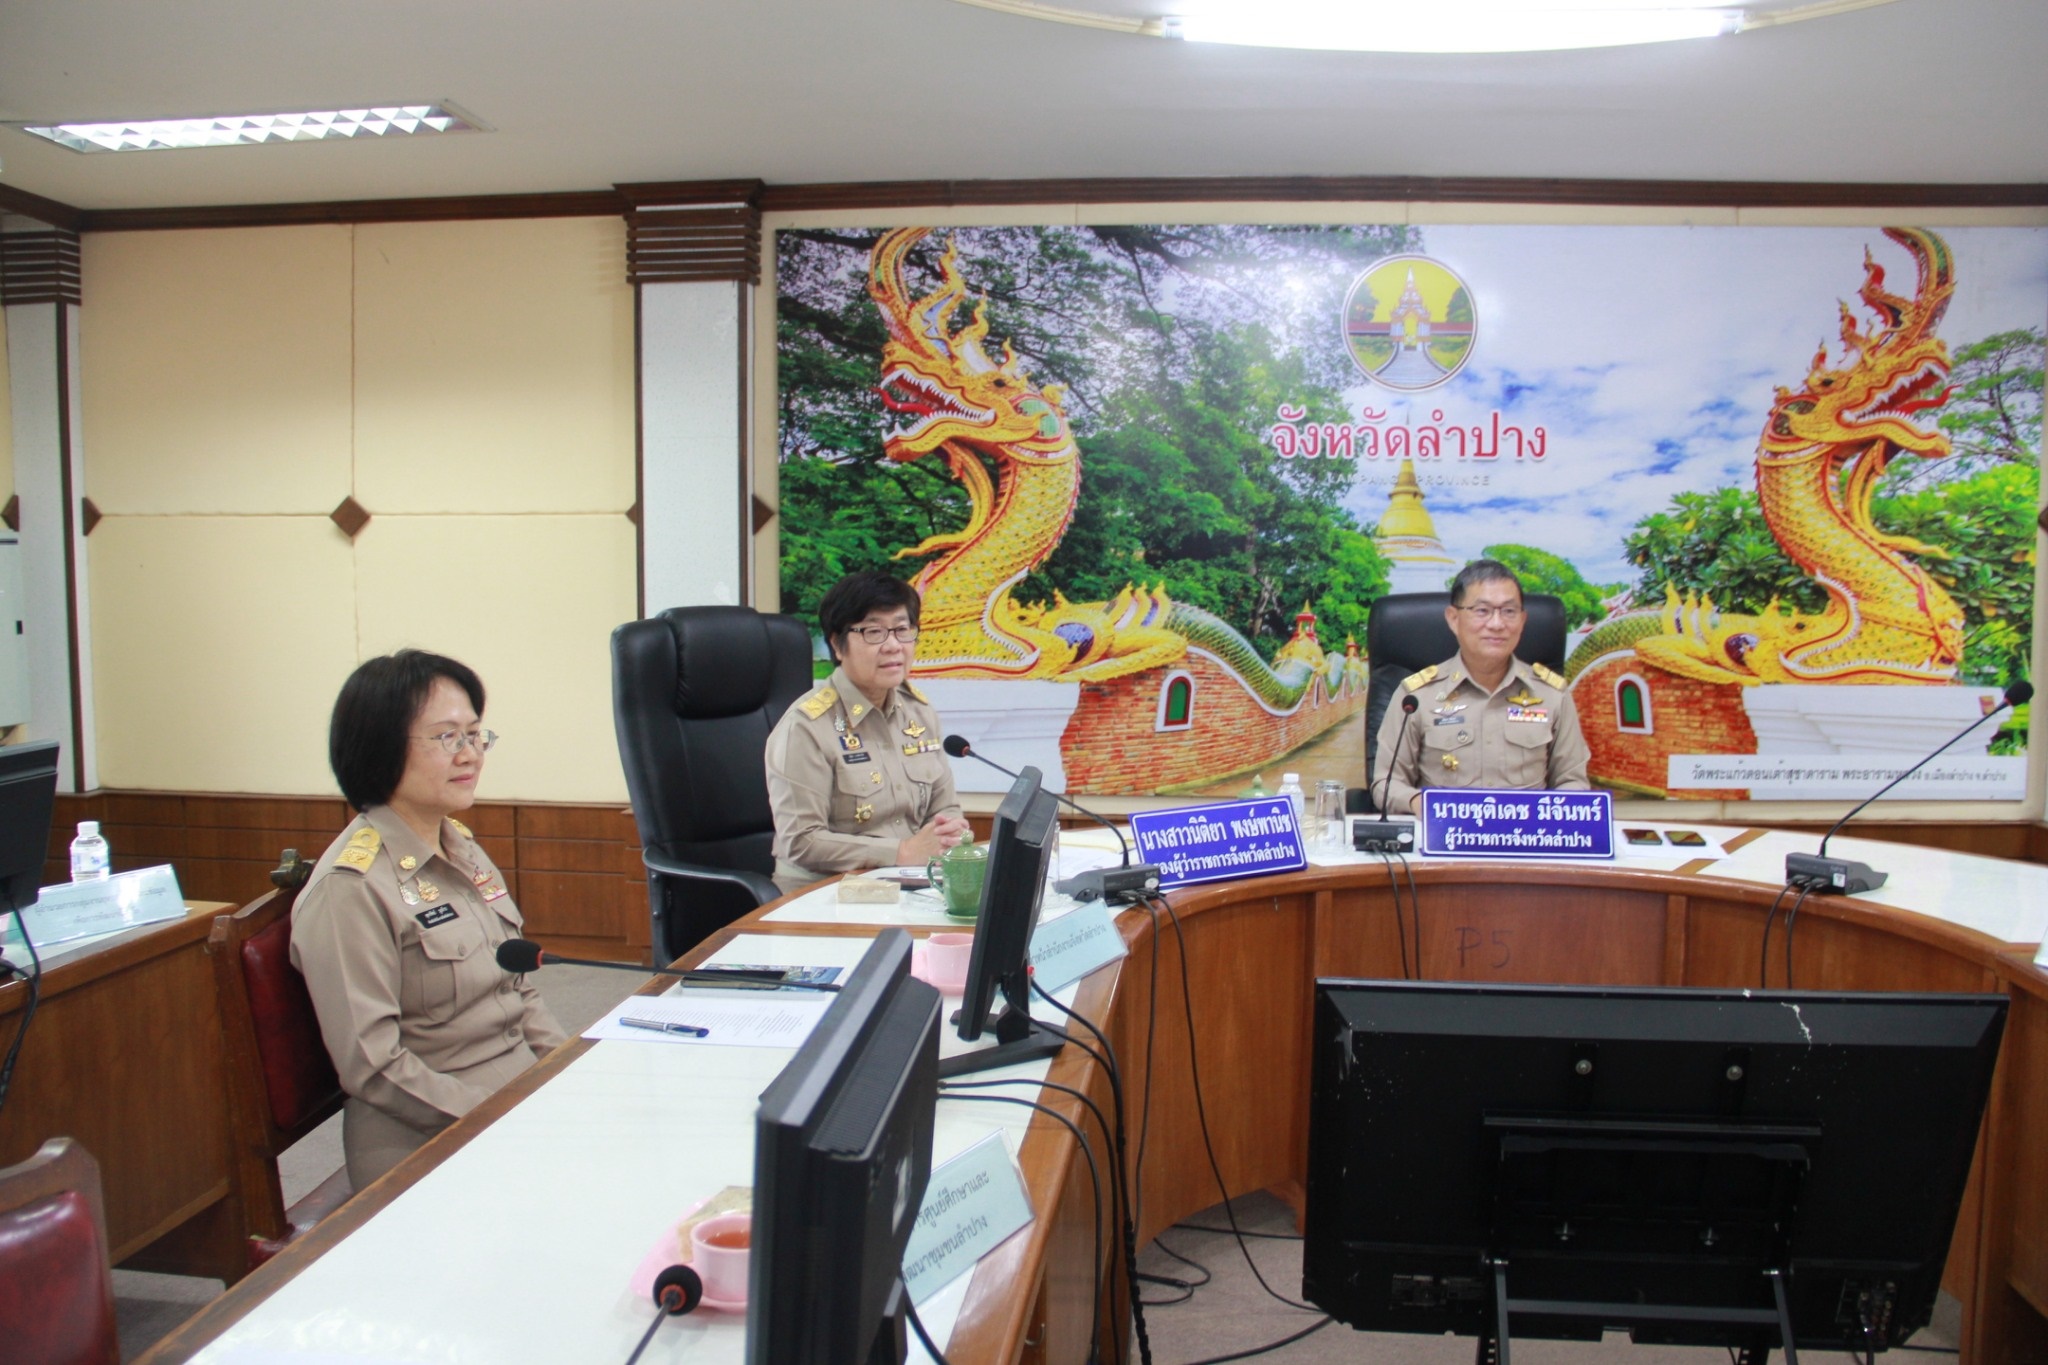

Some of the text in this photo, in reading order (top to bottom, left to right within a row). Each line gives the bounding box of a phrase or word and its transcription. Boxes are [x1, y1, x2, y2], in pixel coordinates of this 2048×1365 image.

[1272, 404, 1547, 459] จังหวัดลำปาง
[1417, 474, 1490, 486] PROVINCE
[1141, 806, 1293, 851] นางสาวนิติยา พงษ์พานิช
[1433, 796, 1602, 827] นายชุติเดช มีจันทร์
[1445, 827, 1592, 850] ผู้ว่าราชการจังหวัดลำปาง
[912, 1170, 990, 1229] ารศูนย์ศึกษาและ
